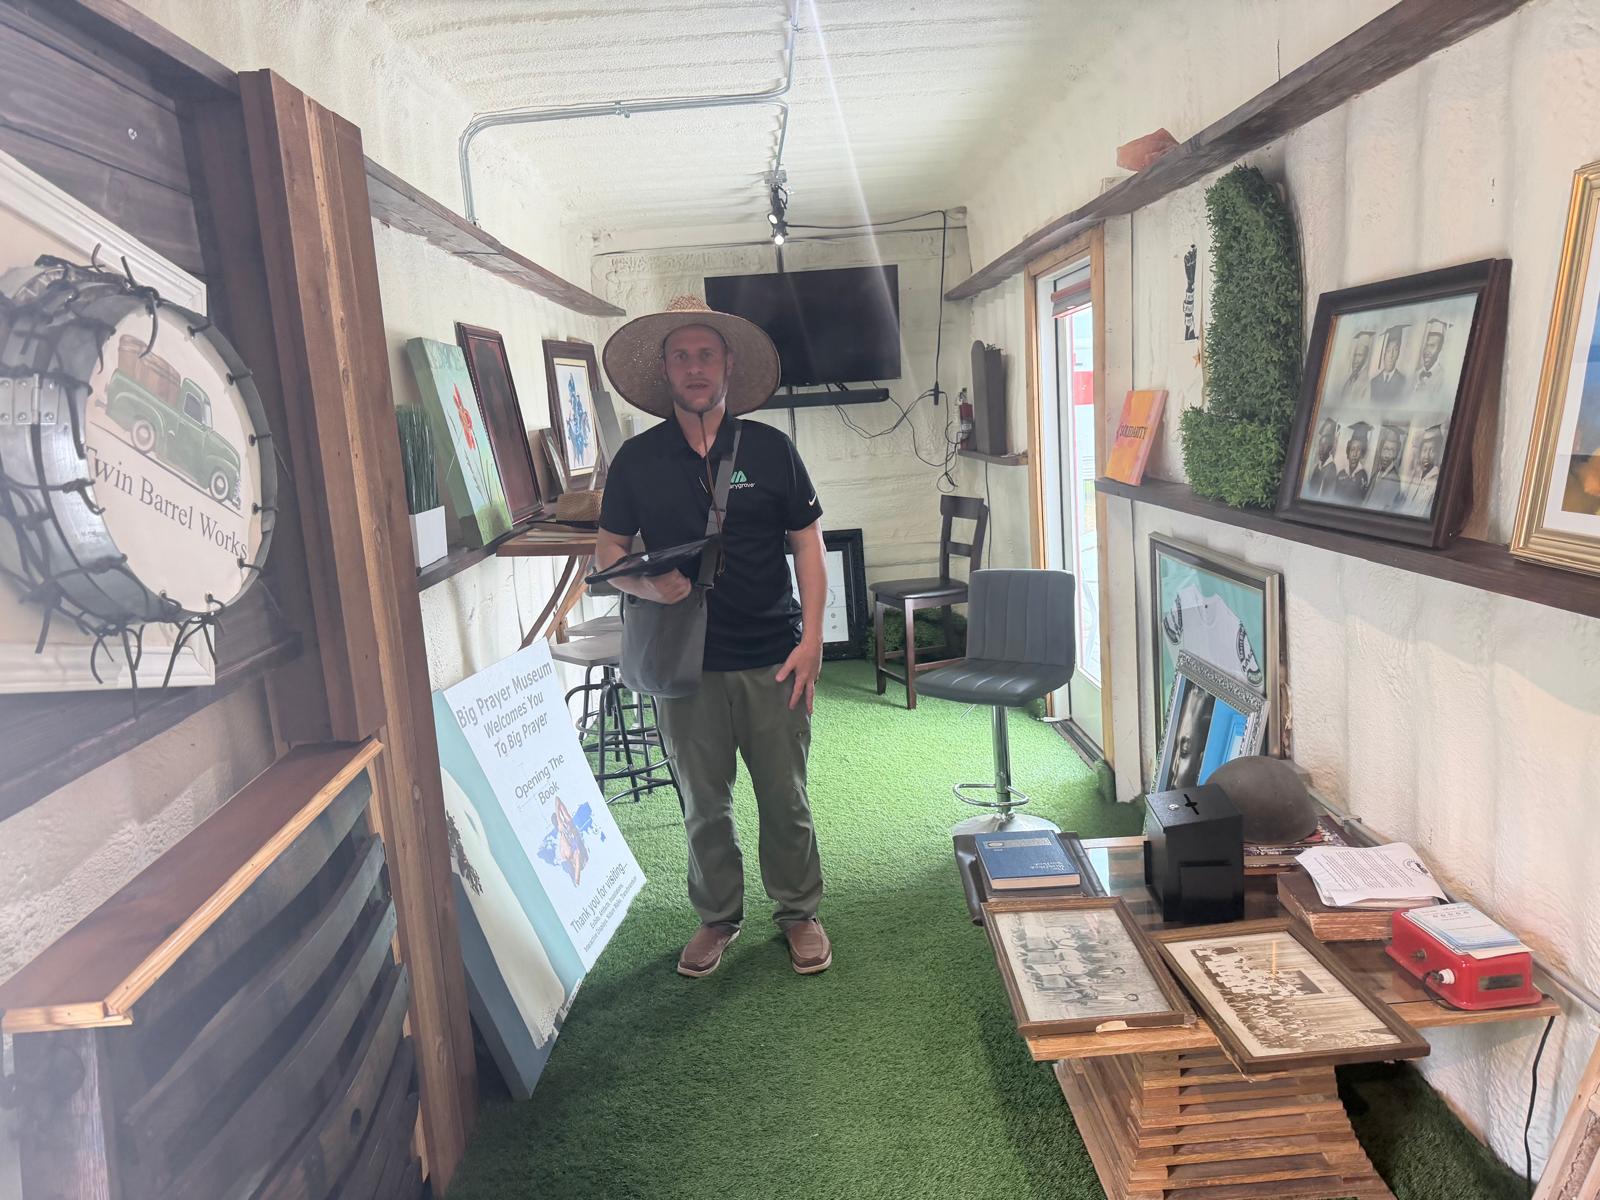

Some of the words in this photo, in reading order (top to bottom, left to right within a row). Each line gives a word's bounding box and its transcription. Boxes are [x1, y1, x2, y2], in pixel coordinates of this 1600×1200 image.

[139, 476, 193, 530] Barrel
[199, 511, 248, 561] Works
[456, 705, 478, 729] Big
[476, 685, 511, 716] Prayer
[511, 662, 553, 695] Museum
[483, 701, 528, 739] Welcomes
[527, 691, 544, 710] You
[494, 739, 508, 758] To
[506, 731, 523, 749] Big
[521, 712, 548, 739] Prayer
[514, 765, 551, 799] Opening
[547, 753, 565, 771] The
[538, 781, 560, 805] Book
[570, 907, 591, 934] Thank
[588, 895, 601, 916] you
[597, 885, 608, 899] for
